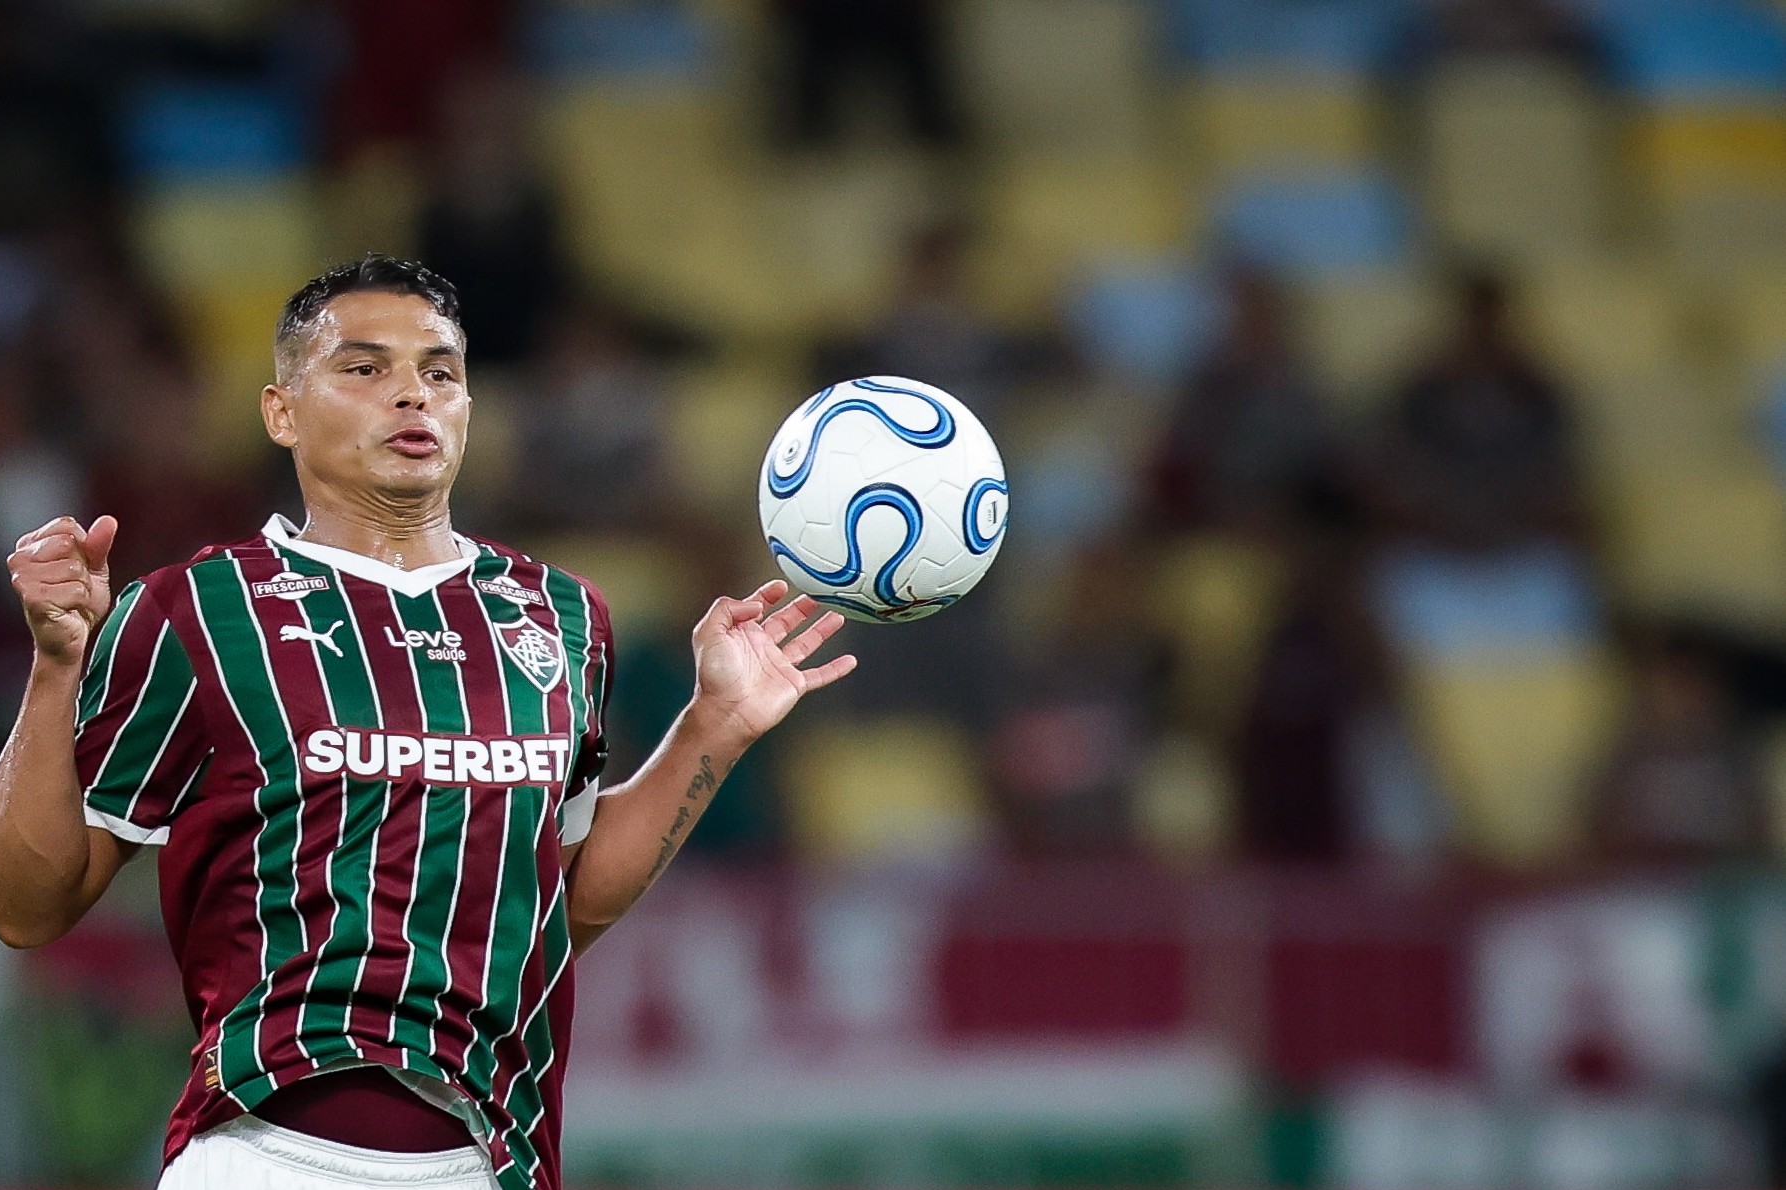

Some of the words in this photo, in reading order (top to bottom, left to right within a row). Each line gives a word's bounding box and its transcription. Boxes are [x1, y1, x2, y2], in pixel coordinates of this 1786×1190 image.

[256, 579, 325, 595] FRESCATTO
[481, 582, 541, 602] FRESCATTO
[383, 626, 463, 648] Leve
[427, 646, 467, 661] saúde
[305, 729, 570, 782] SUPERBET
